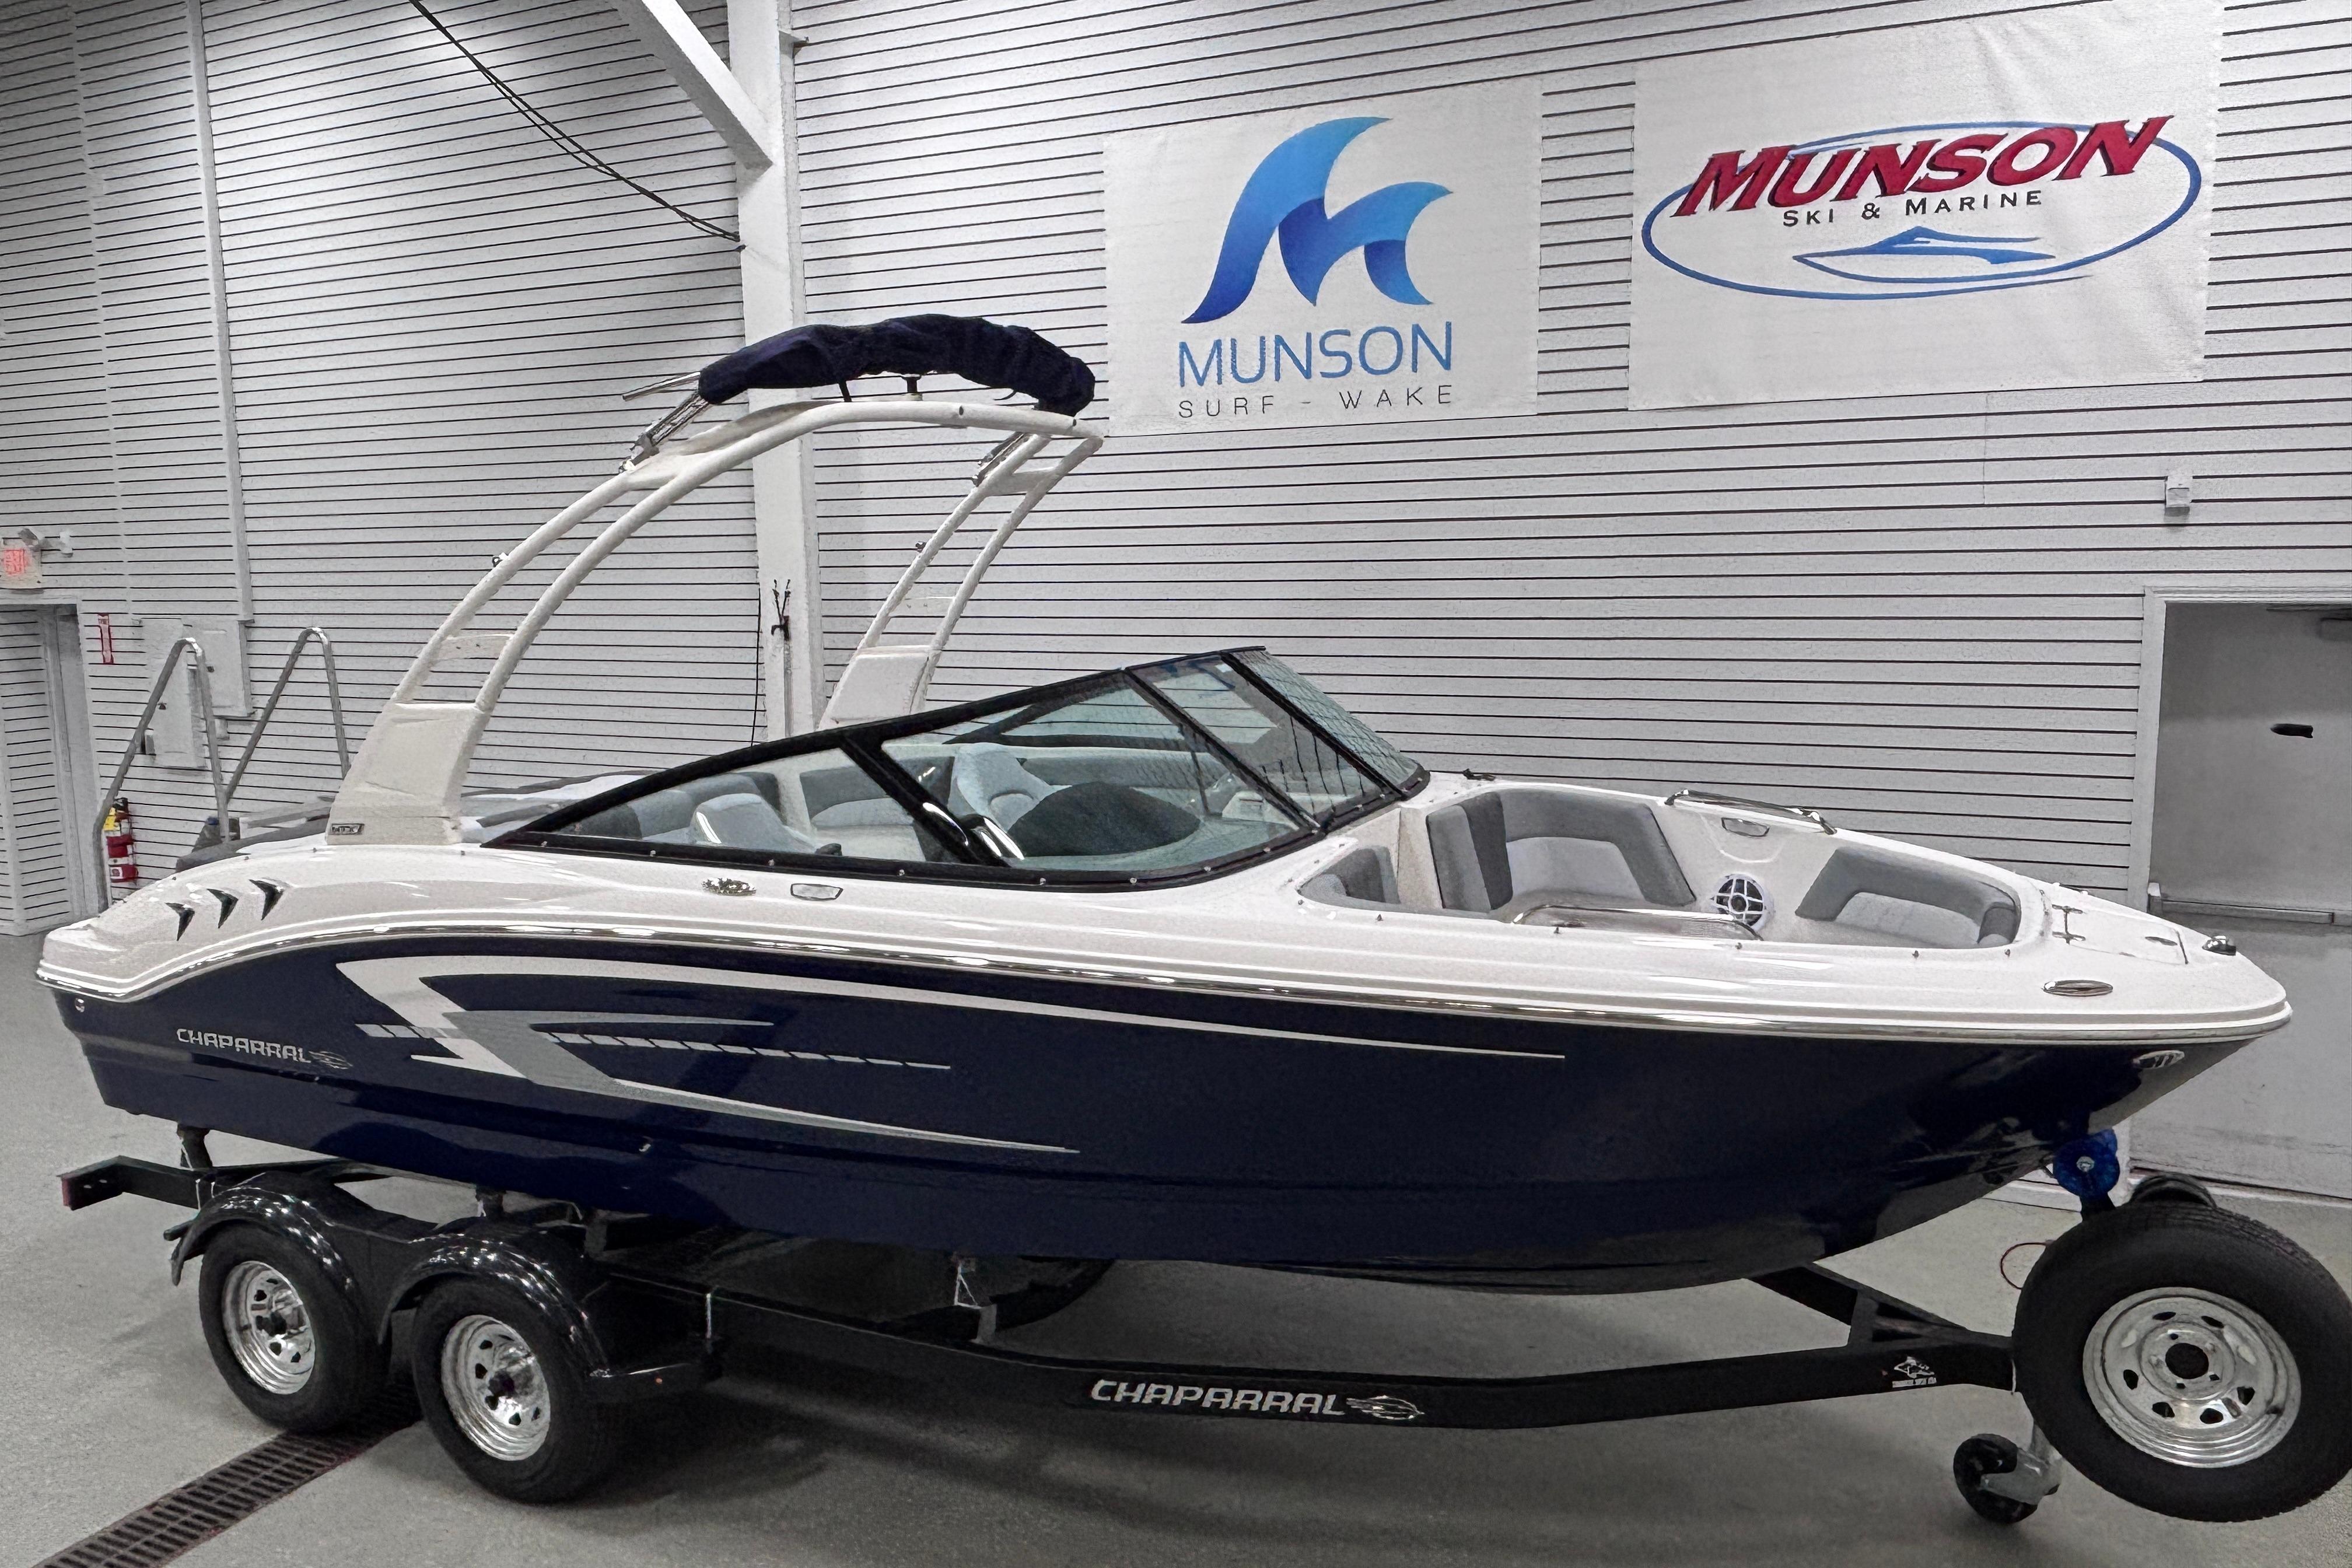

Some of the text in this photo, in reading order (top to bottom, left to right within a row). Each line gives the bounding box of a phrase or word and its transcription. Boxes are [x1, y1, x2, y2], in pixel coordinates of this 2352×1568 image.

[1670, 115, 2176, 218] MUNSON
[1783, 190, 2043, 228] SKI & MARINE
[1178, 321, 1452, 387] MUNSON
[1178, 395, 1274, 419] SURF
[1339, 384, 1452, 410] WAKE
[176, 1028, 312, 1063] CHAPARRAL
[1090, 1379, 1345, 1415] CHAPARRAL
